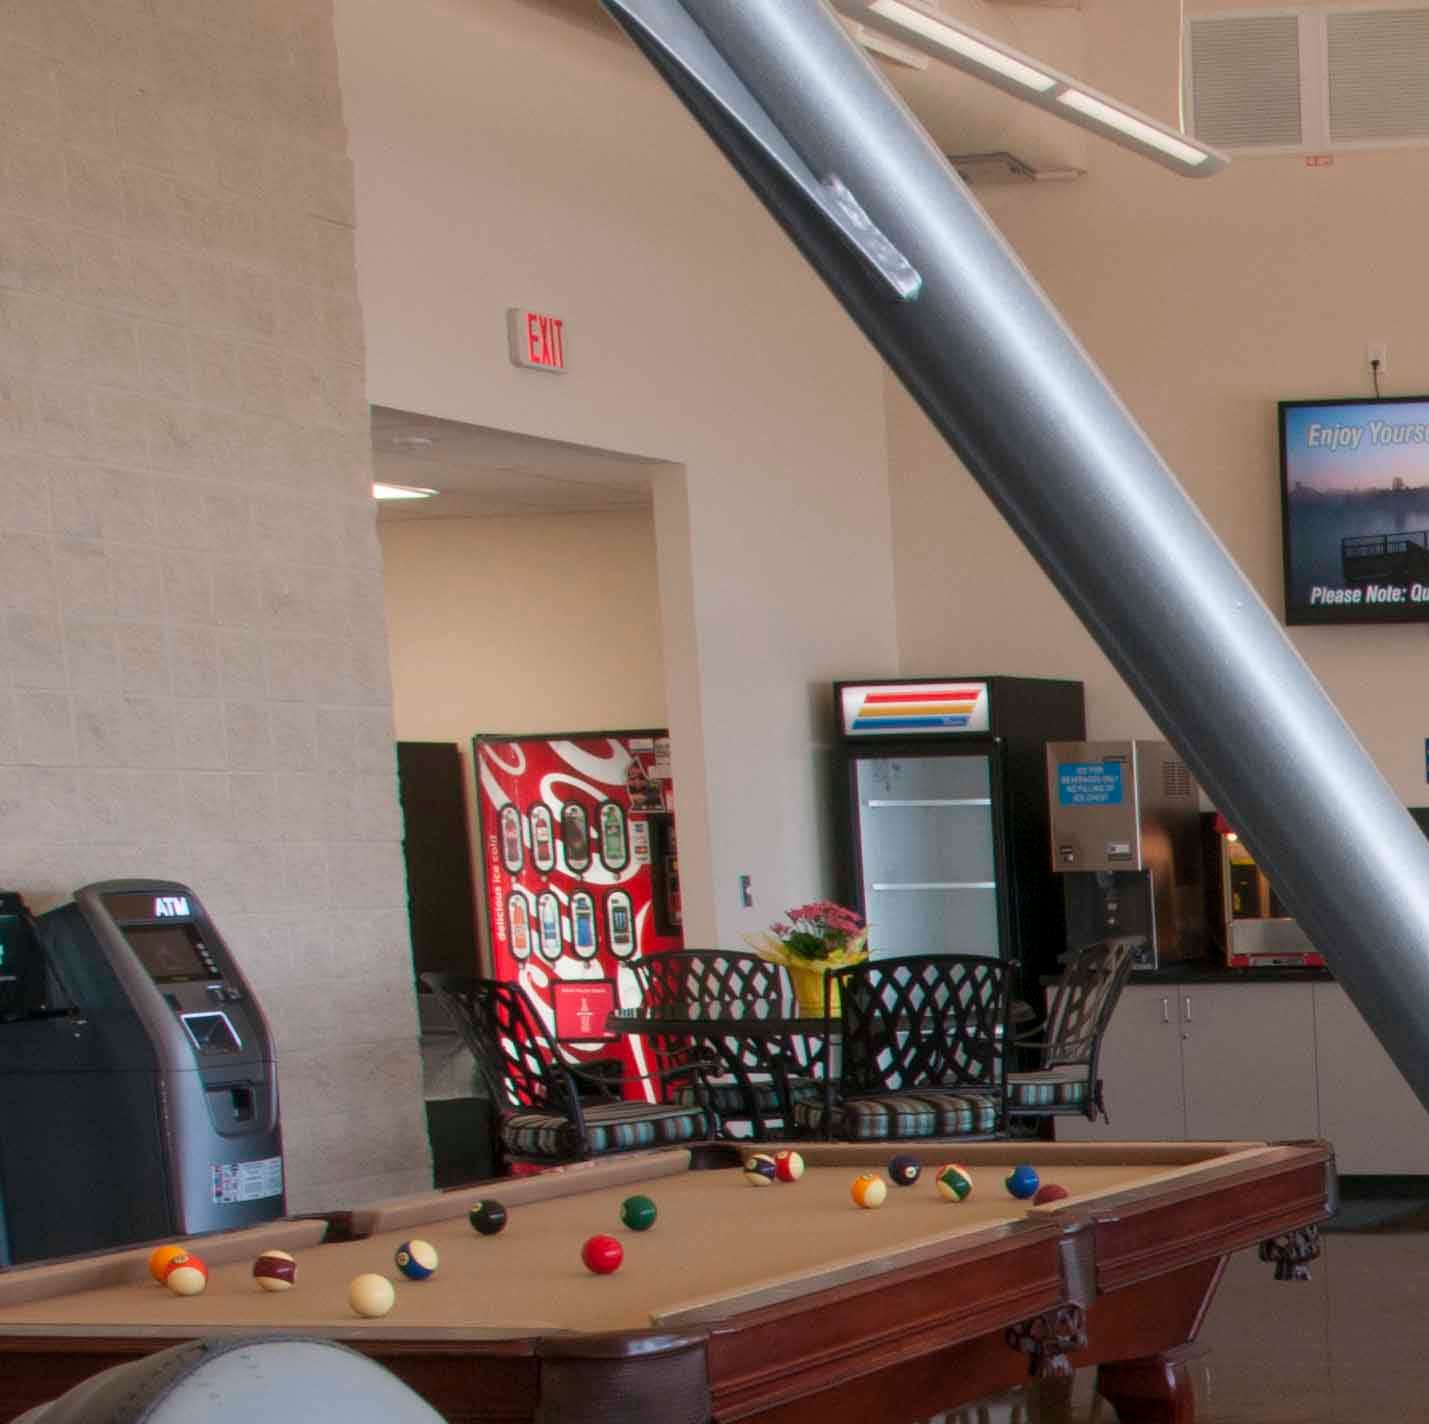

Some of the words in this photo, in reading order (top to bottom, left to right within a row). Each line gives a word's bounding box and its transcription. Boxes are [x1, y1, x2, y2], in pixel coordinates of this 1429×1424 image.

[526, 311, 565, 369] EXIT
[1307, 422, 1361, 451] Enjoy
[1311, 585, 1363, 605] Please
[1365, 583, 1407, 604] Note:
[490, 835, 499, 862] cold
[493, 865, 502, 882] ice
[154, 896, 190, 917] ATM
[494, 887, 506, 941] delicious
